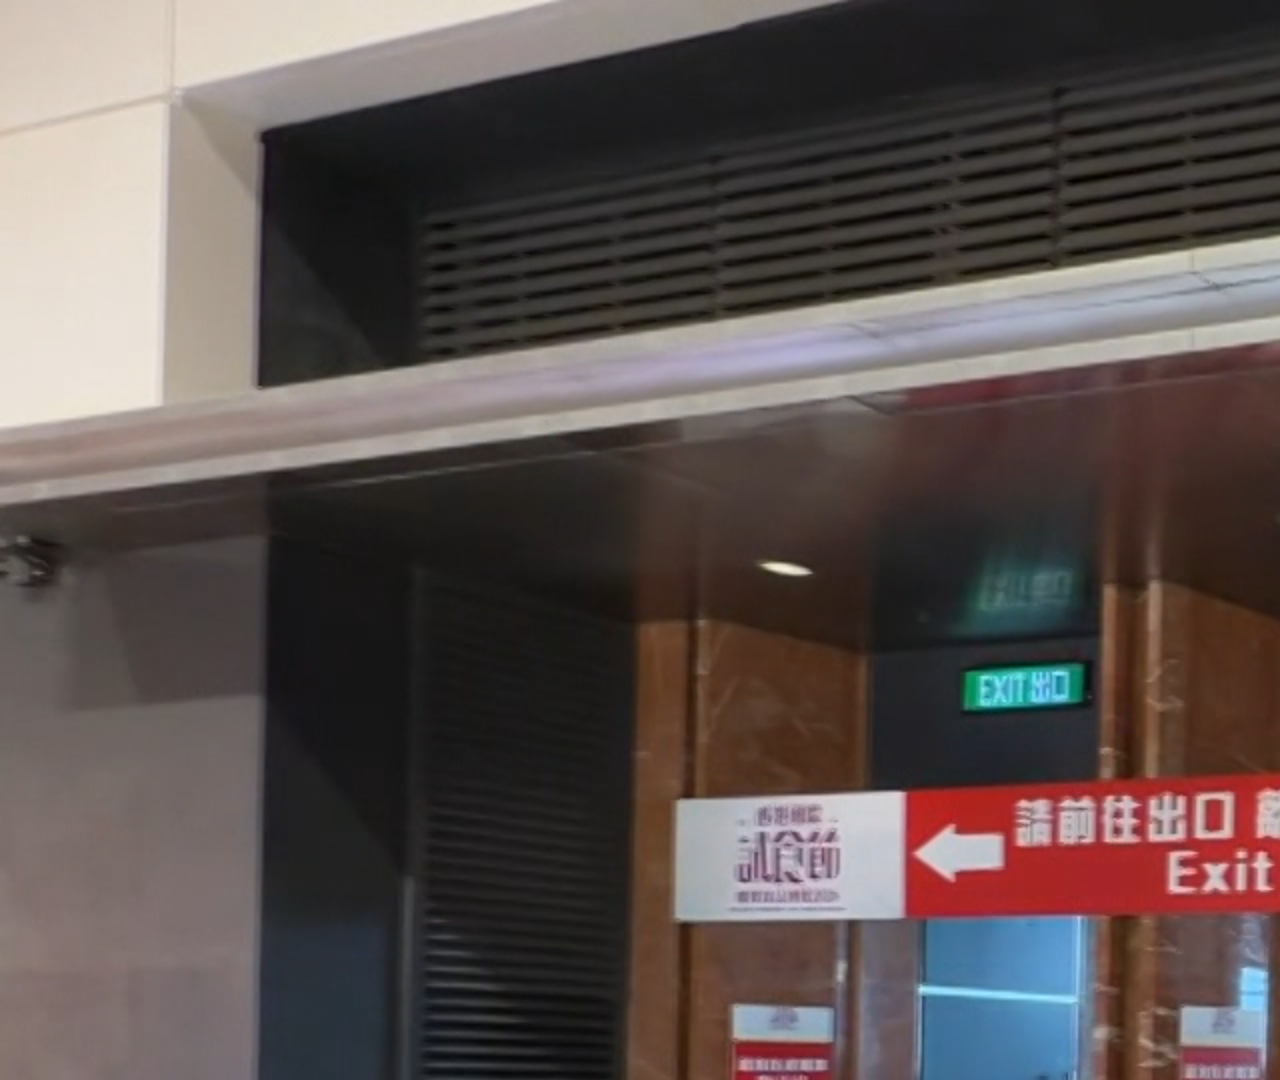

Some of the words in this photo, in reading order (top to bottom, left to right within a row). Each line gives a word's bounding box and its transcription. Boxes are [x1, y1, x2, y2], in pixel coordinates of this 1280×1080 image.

[979, 671, 1023, 706] EXIT
[1032, 670, 1069, 704] 出口
[1013, 791, 1234, 847] 請前往出口
[1167, 848, 1275, 894] Exit
